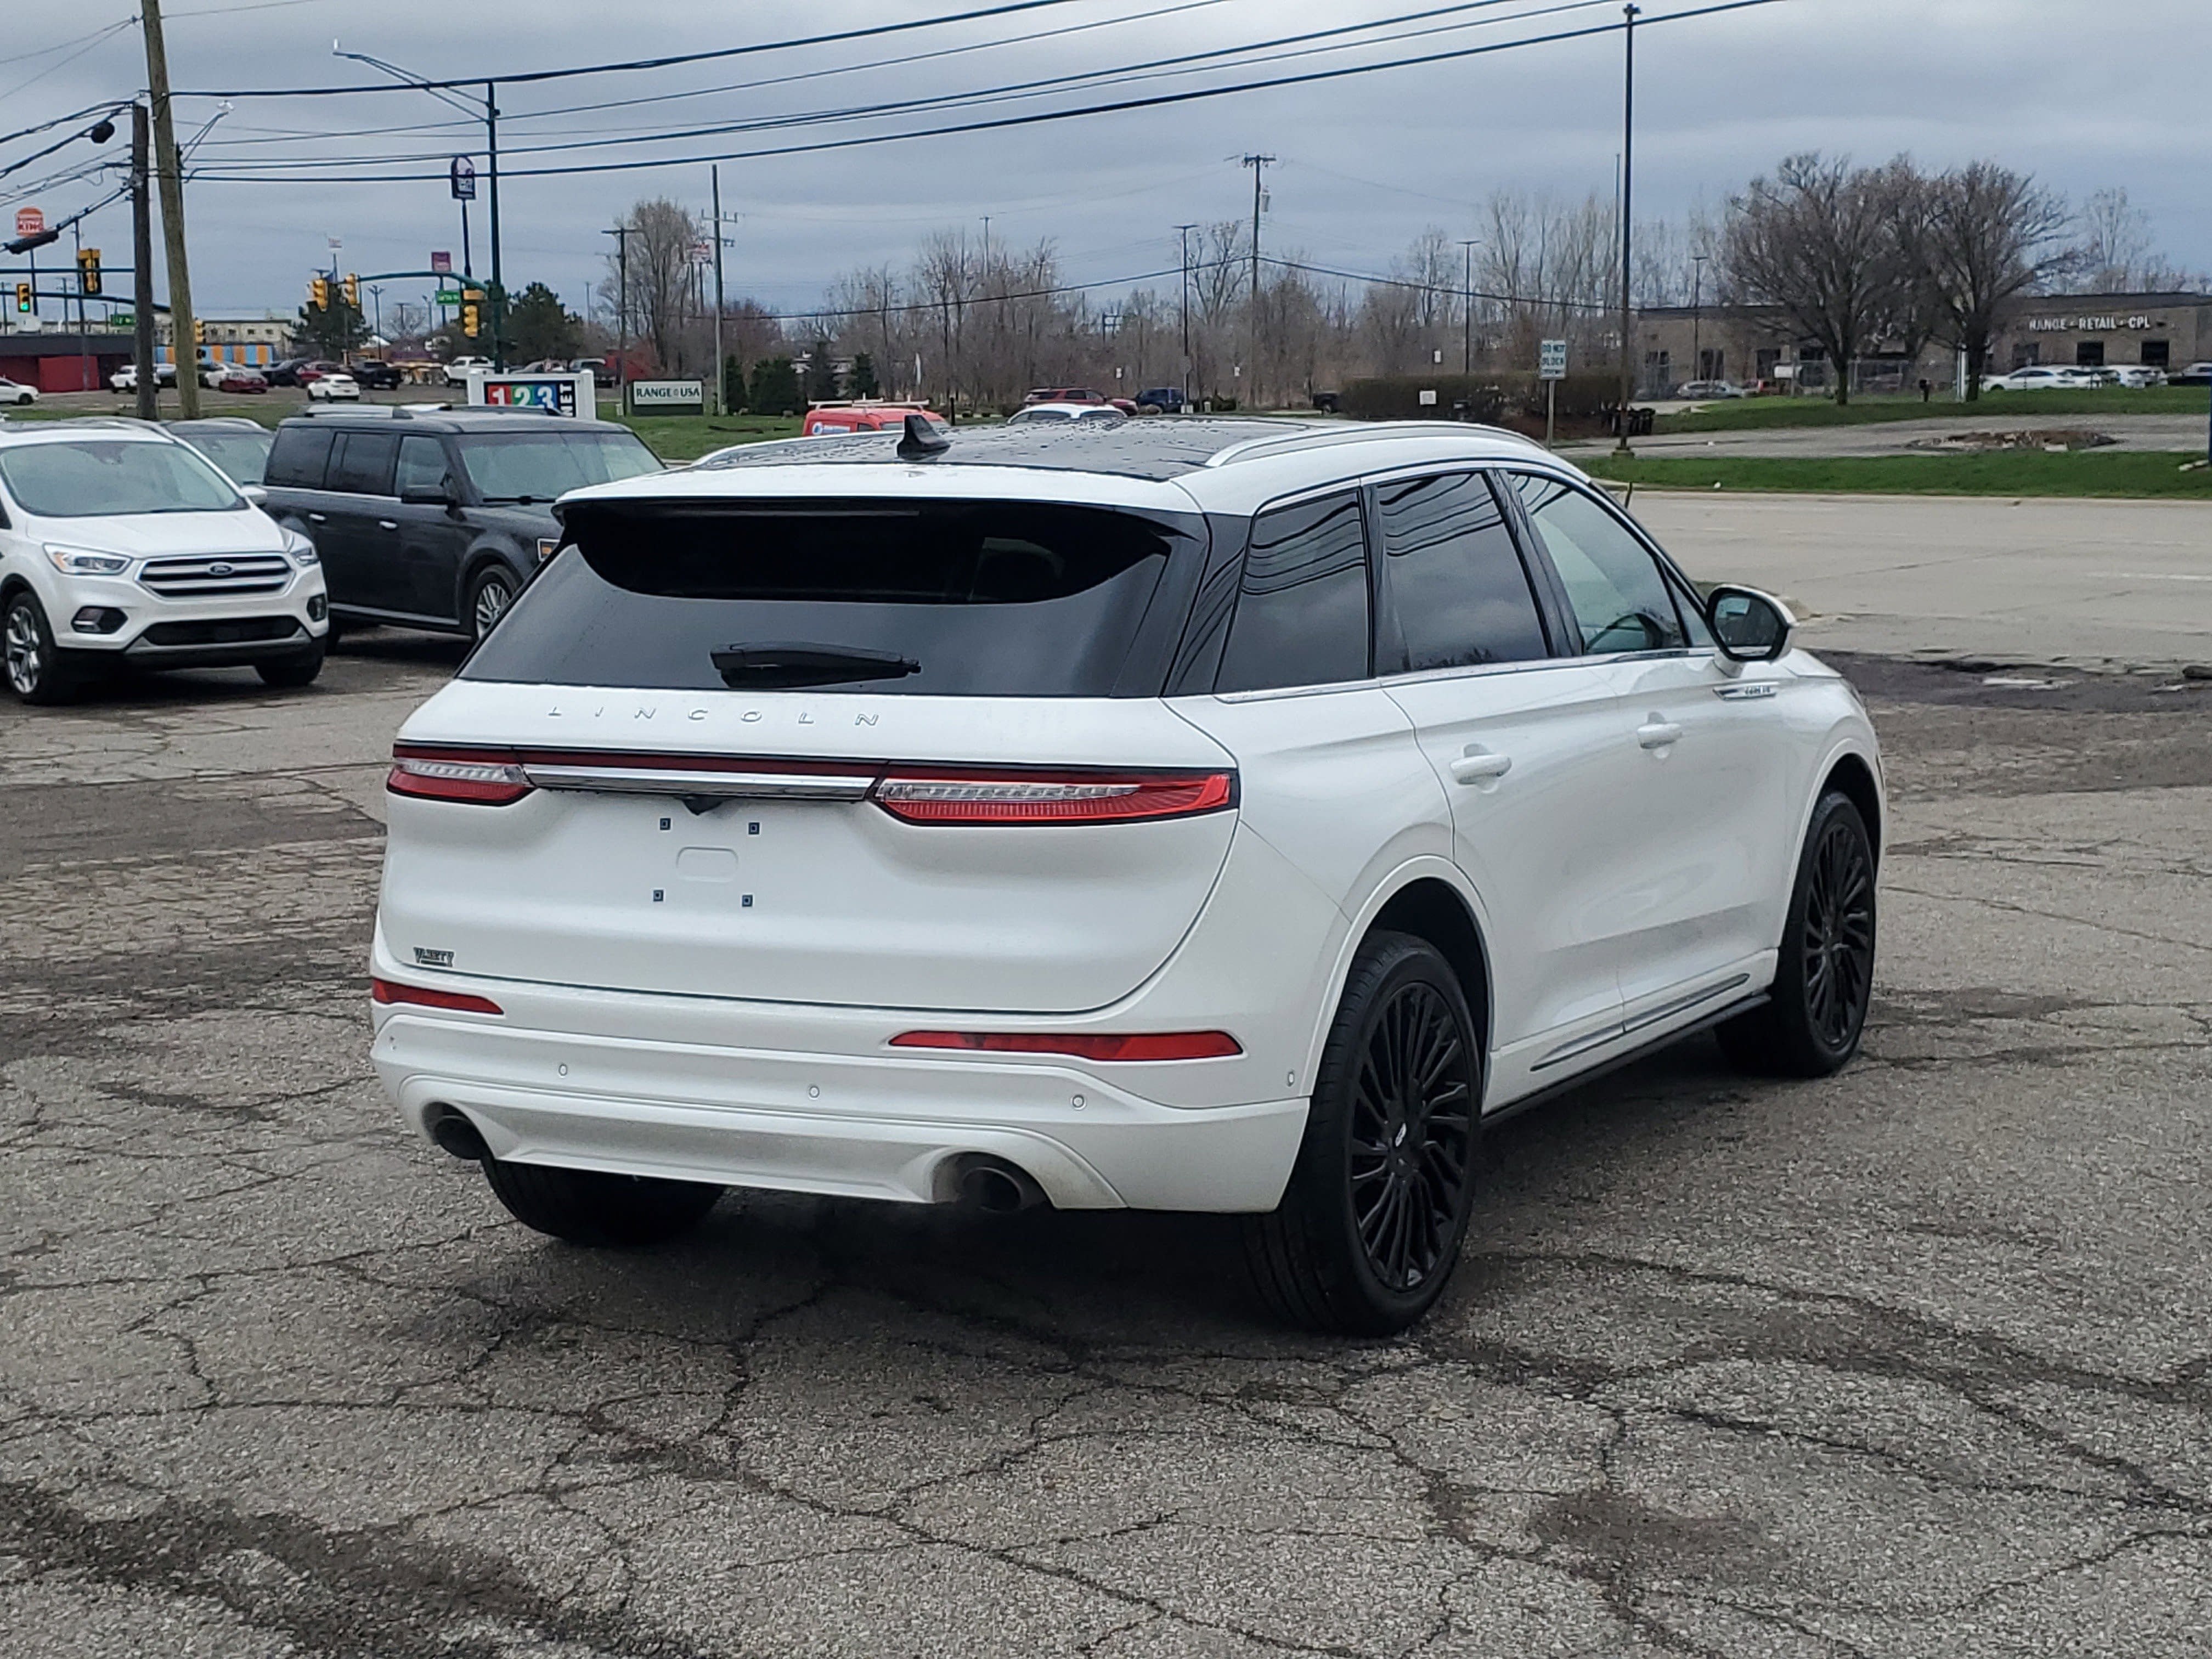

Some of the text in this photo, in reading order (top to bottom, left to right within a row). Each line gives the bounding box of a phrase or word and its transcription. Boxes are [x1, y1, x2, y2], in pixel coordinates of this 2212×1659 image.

[2078, 315, 2117, 330] RETAIL
[2128, 315, 2150, 329] CPL
[636, 387, 700, 397] RANGE USA
[548, 705, 879, 727] LINCOLN
